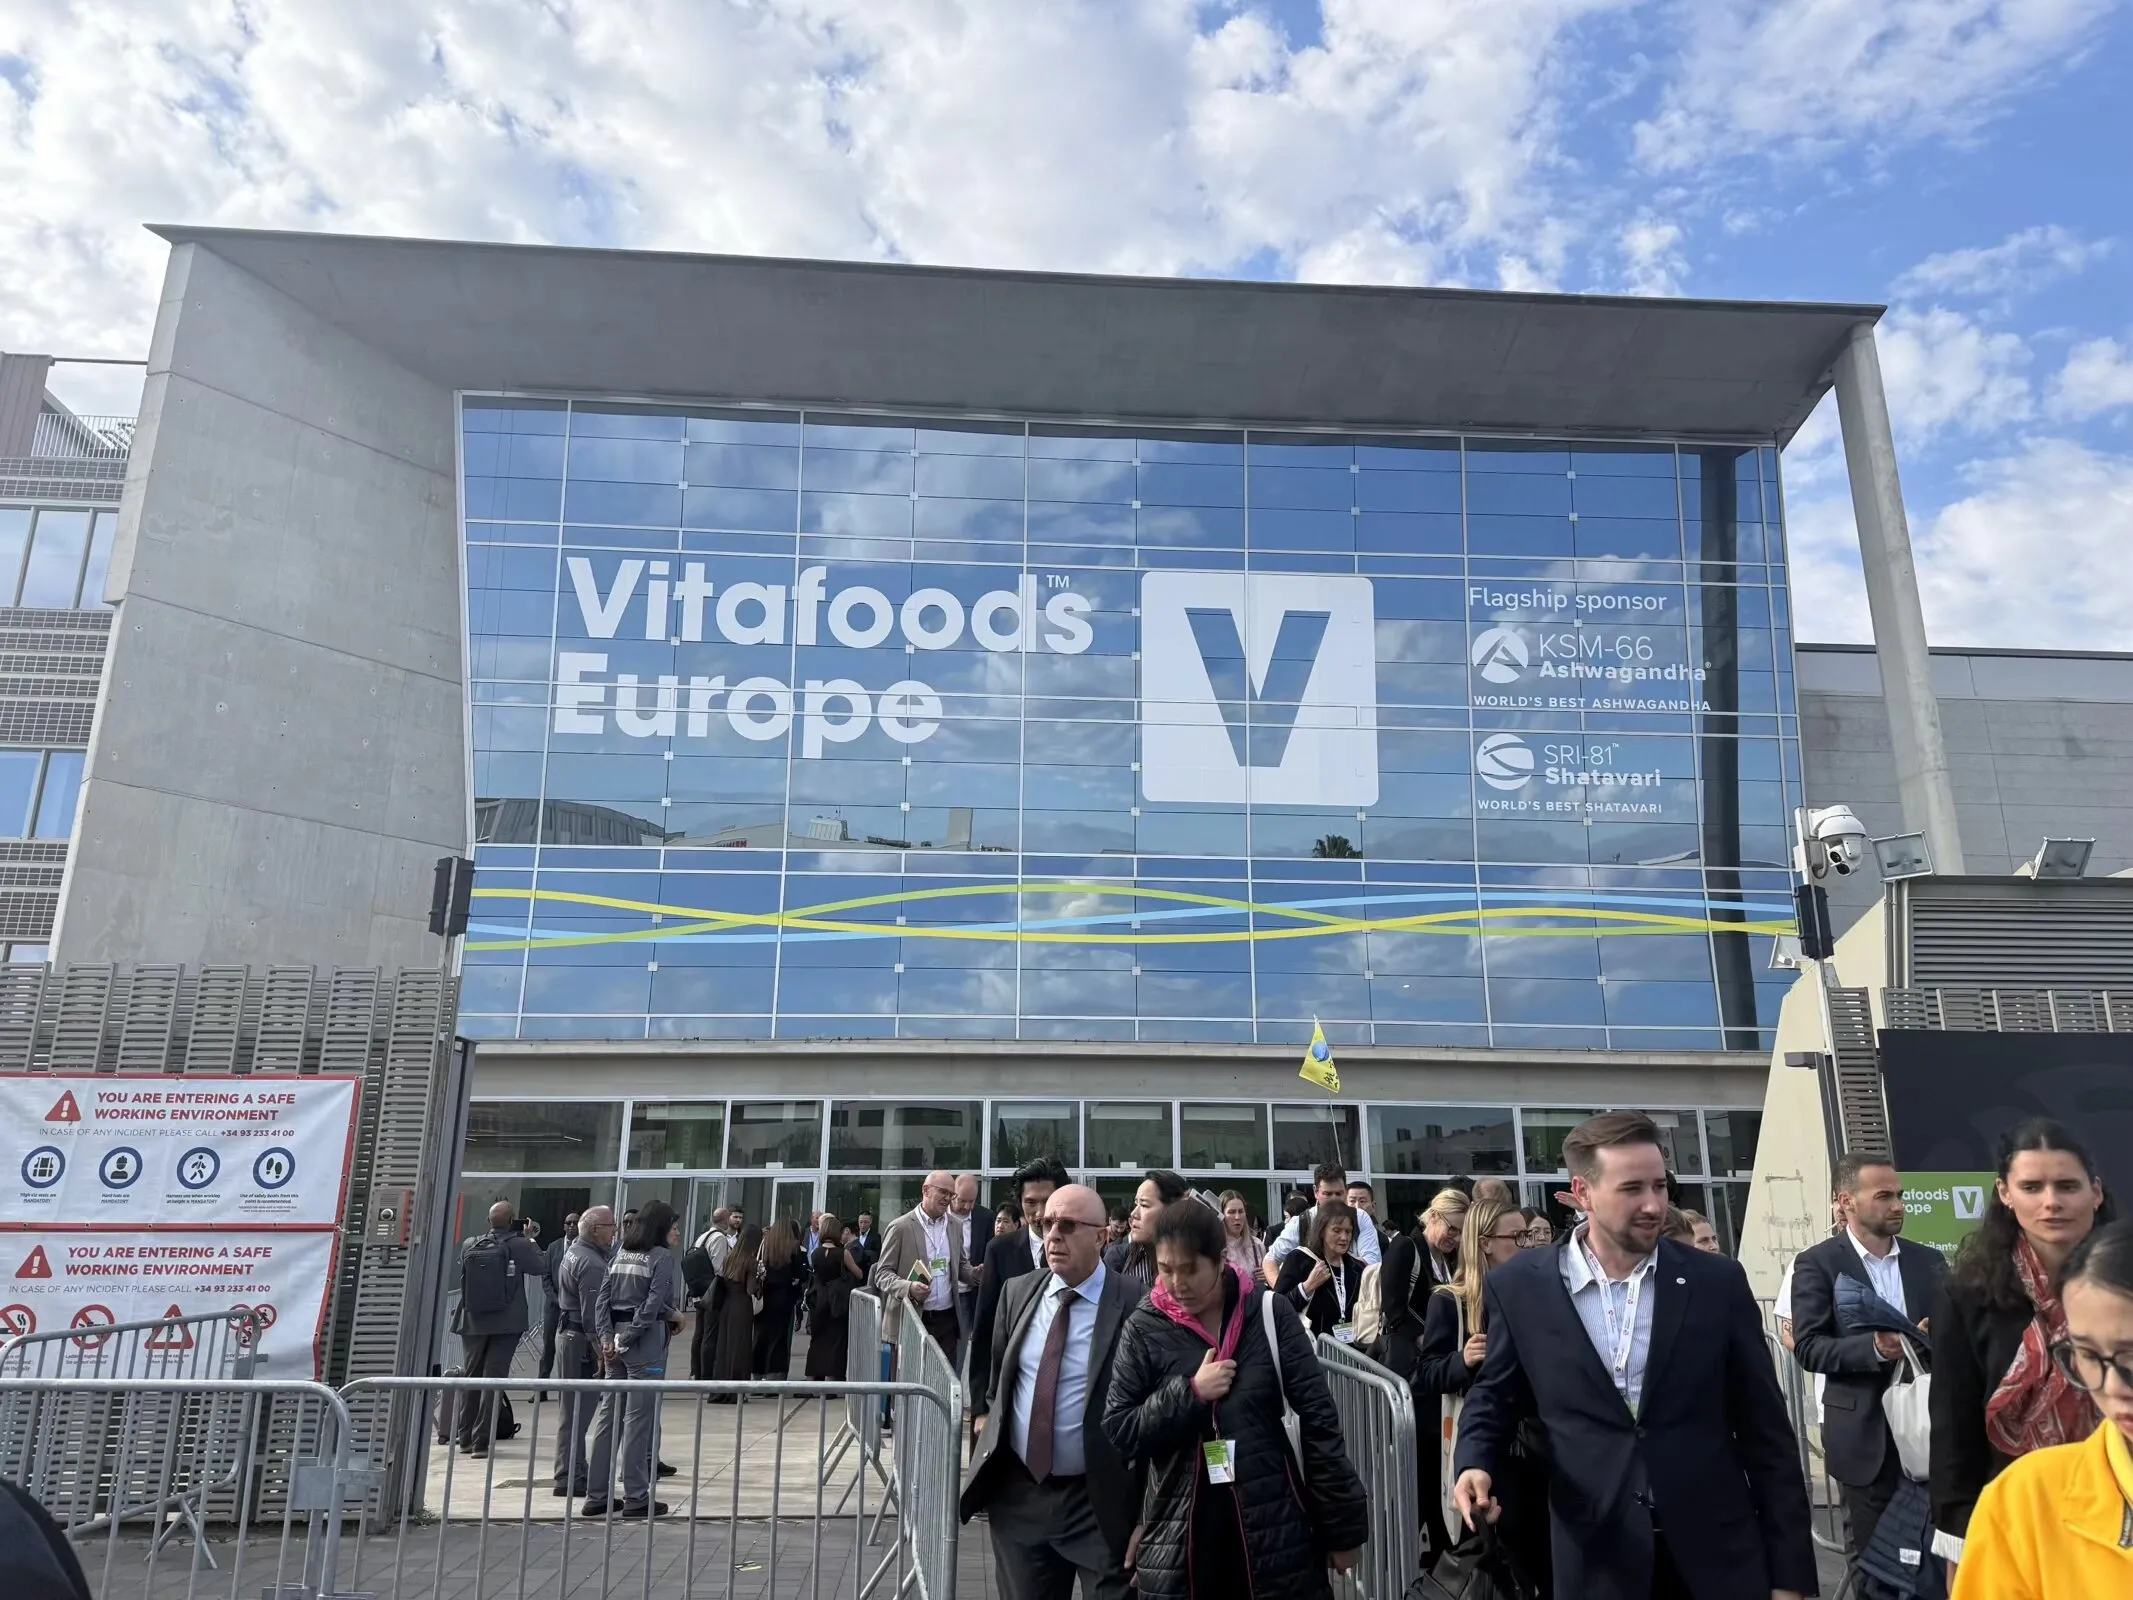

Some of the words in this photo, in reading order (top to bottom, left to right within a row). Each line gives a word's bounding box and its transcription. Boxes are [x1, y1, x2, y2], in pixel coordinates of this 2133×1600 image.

[566, 557, 1094, 655] Vitafoods
[1469, 587, 1568, 612] Flagship
[1575, 593, 1667, 613] sponsor
[1539, 633, 1653, 660] KSM-66
[554, 652, 943, 759] Europe
[1473, 695, 1542, 707] WORLD'S
[1549, 697, 1586, 708] BEST
[1592, 698, 1711, 711] ASHWAGANDHA
[1544, 744, 1612, 765] SRI-81
[1545, 767, 1661, 787] Shatavari
[1477, 800, 1540, 811] WORLD'S
[1546, 801, 1579, 812] BEST
[1585, 802, 1662, 814] SHATAVARI
[97, 1092, 128, 1103] YOU
[132, 1093, 161, 1103] ARE
[165, 1093, 239, 1104] ENTERING
[243, 1093, 253, 1104] A
[257, 1093, 296, 1104] SAFE
[94, 1109, 166, 1120] WORKING
[170, 1109, 279, 1120] ENVIRONMENT
[39, 1128, 49, 1136] IN
[50, 1128, 75, 1136] CASE
[76, 1128, 91, 1136] OF
[159, 1129, 193, 1137] PLEASE
[195, 1129, 218, 1137] CALL
[68, 1247, 99, 1258] YOU
[103, 1247, 134, 1258] ARE
[138, 1247, 215, 1258] ENTERING
[218, 1247, 228, 1258] A
[233, 1247, 272, 1258] SAFE
[65, 1264, 138, 1276] WORKING
[142, 1264, 254, 1275] ENVIRONMENT
[9, 1285, 18, 1293] IN
[20, 1285, 45, 1293] CASE
[48, 1285, 61, 1293] OF
[62, 1285, 83, 1293] ANY
[86, 1285, 129, 1293] INCIDENT
[131, 1285, 166, 1293] PLEASE
[168, 1285, 191, 1293] CALL
[195, 1285, 211, 1293] +34
[213, 1285, 225, 1293] 93
[227, 1285, 244, 1293] 233
[246, 1285, 256, 1293] 41
[258, 1285, 271, 1293] 00
